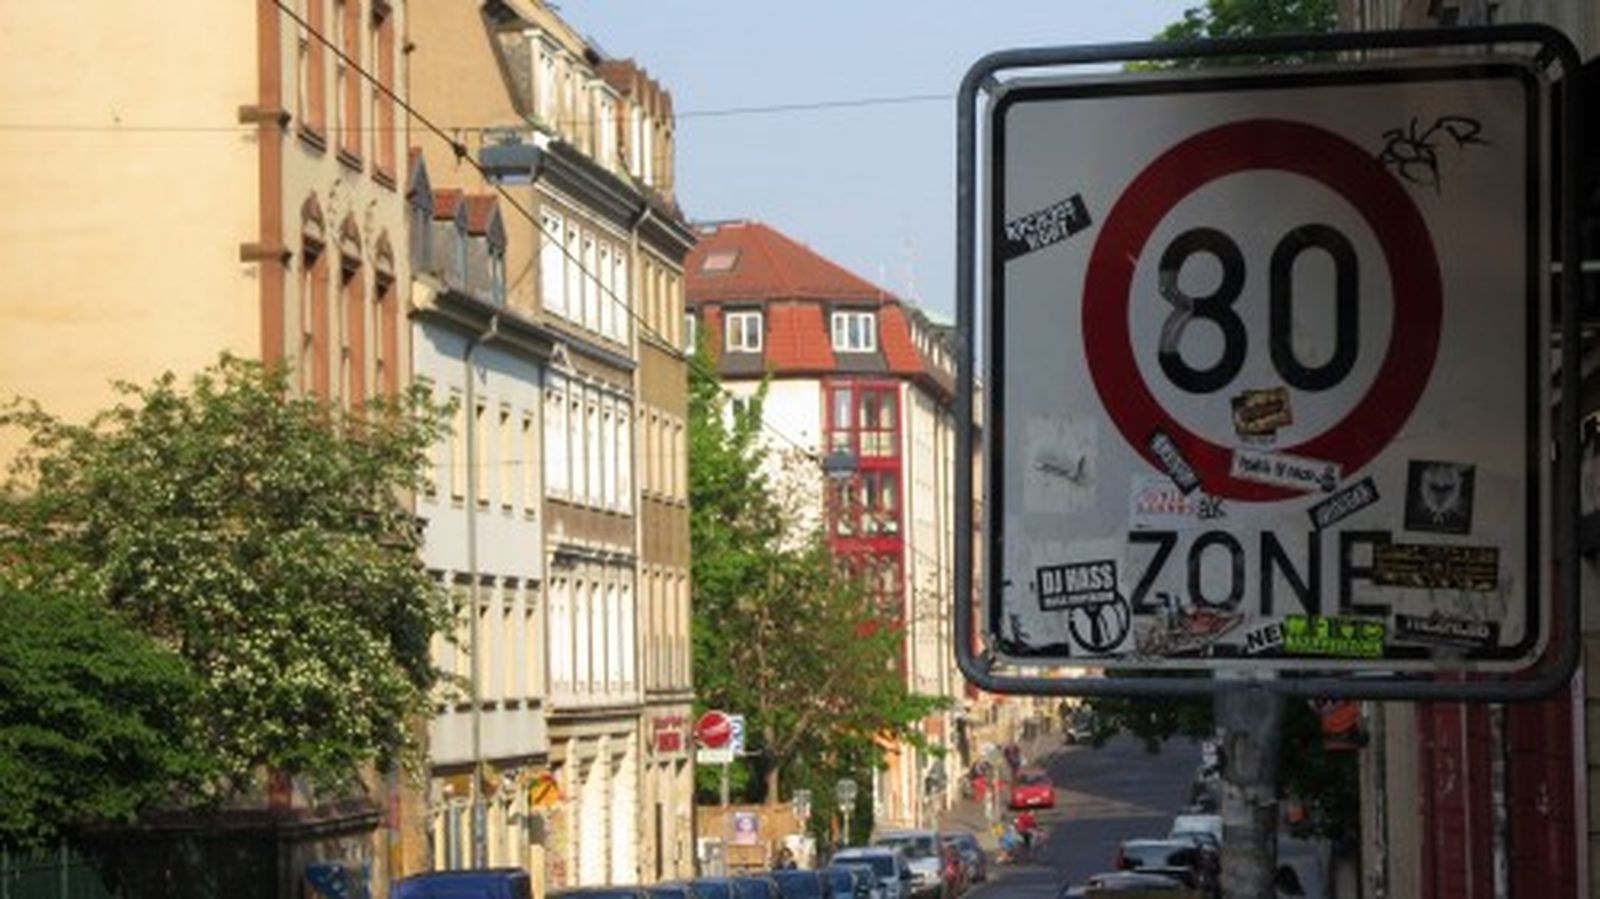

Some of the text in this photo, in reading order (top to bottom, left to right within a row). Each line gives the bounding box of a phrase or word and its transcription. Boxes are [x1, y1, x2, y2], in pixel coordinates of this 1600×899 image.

[1158, 223, 1360, 394] 80
[1042, 569, 1062, 595] DJ
[1128, 530, 1392, 616] ZONE
